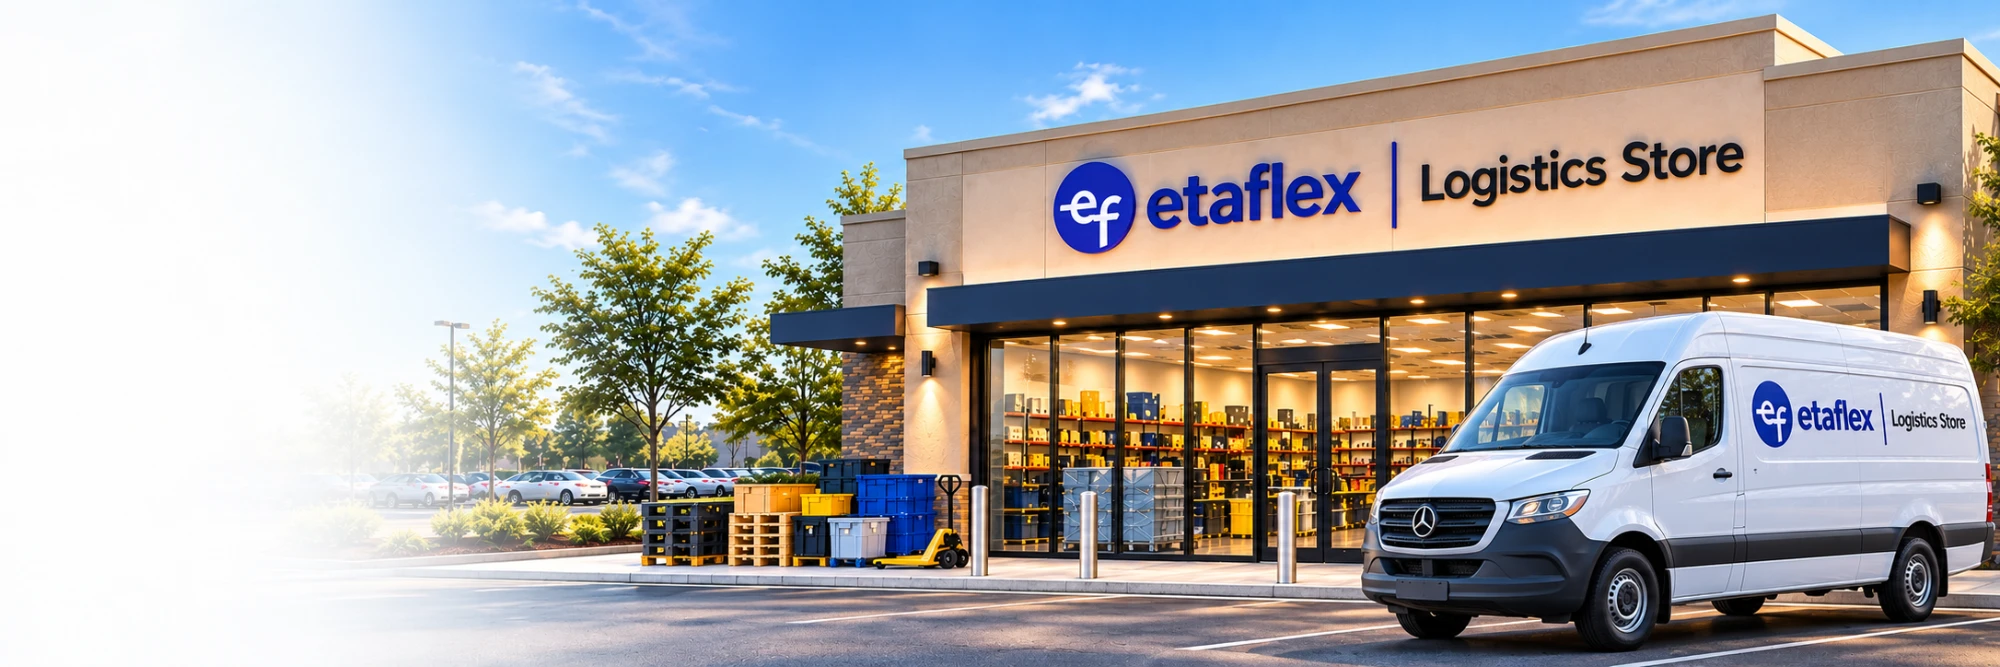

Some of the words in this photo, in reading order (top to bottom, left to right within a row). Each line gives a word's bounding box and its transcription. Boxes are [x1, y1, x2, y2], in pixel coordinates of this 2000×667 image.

[1059, 190, 1122, 248] ef
[1146, 162, 1361, 229] etaflex
[1421, 149, 1607, 207] Logistics
[1621, 141, 1744, 182] Store
[1756, 400, 1787, 442] ef
[1798, 399, 1875, 431] etaflex
[1891, 409, 1938, 432] Logistics
[1939, 412, 1966, 430] Store
